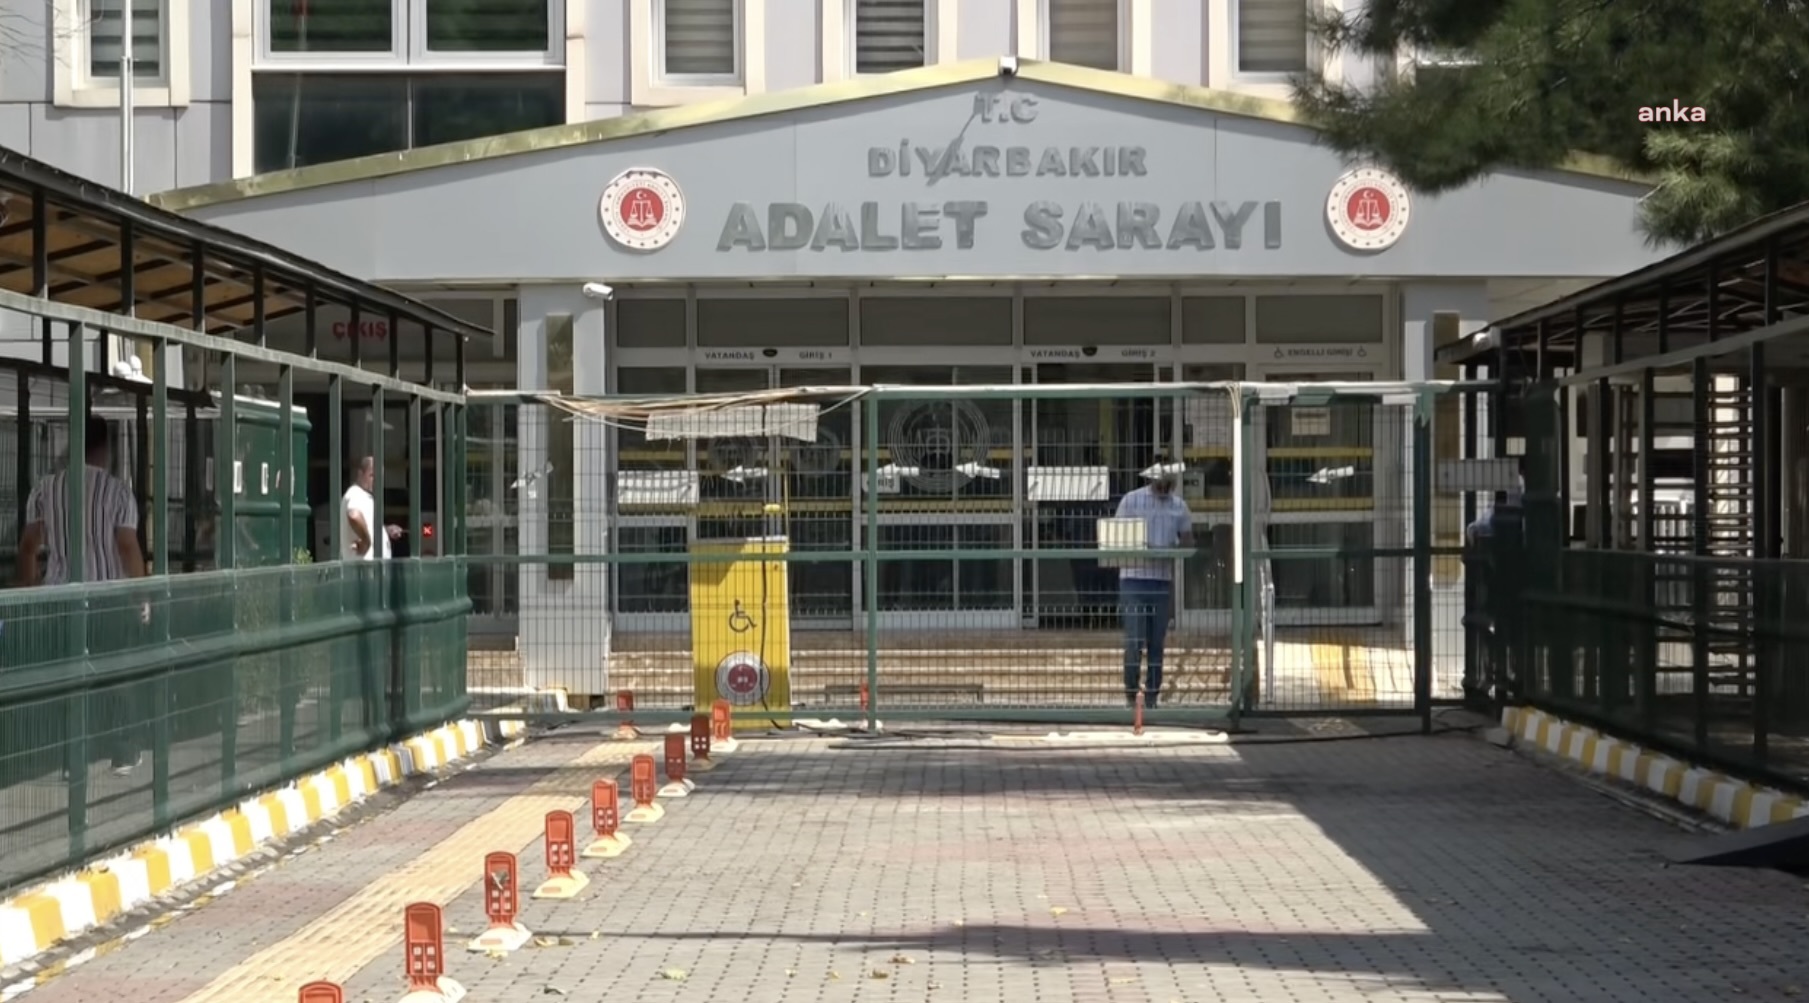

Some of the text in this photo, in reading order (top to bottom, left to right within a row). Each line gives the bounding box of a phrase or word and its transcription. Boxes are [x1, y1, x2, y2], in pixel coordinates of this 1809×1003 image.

[974, 92, 1039, 124] T.C
[867, 138, 1149, 178] DİYARBAKIR
[715, 201, 989, 252] ADALET
[1020, 200, 1282, 251] SARAYI
[705, 351, 755, 361] VATANDAŞ
[1030, 350, 1081, 359] VATANDAŞ
